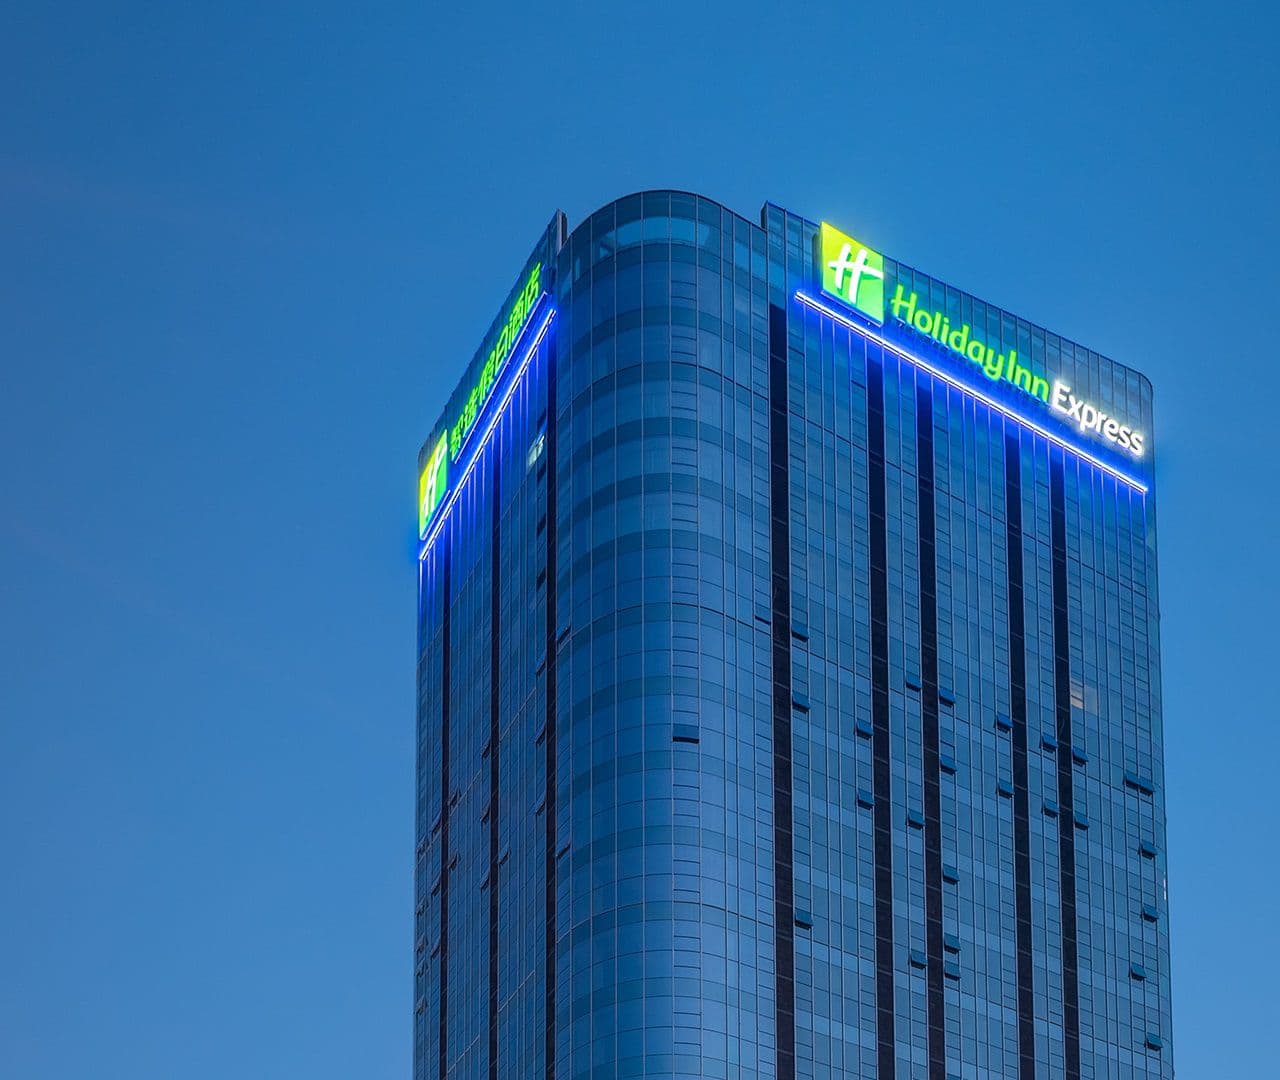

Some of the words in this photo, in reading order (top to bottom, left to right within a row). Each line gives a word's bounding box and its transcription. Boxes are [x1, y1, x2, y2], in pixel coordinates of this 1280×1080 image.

[891, 284, 1005, 381] Holiday
[1006, 350, 1051, 403] Inn
[1049, 380, 1145, 457] Express
